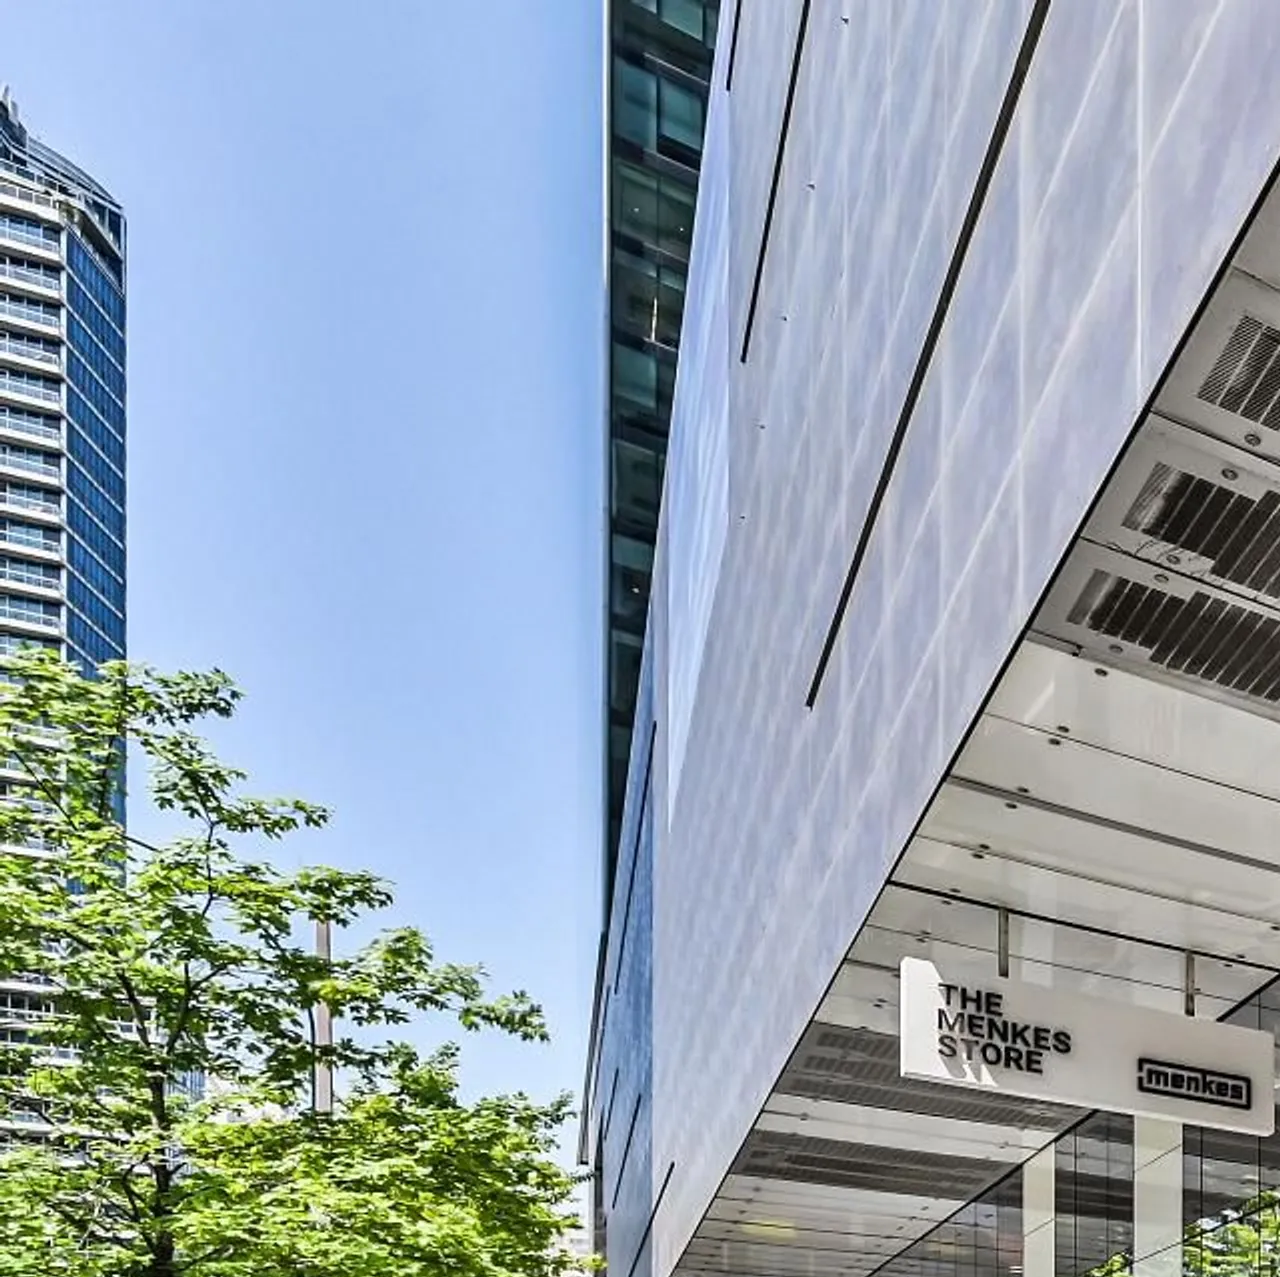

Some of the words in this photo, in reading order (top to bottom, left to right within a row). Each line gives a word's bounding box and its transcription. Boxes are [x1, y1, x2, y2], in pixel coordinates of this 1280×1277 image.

[938, 983, 1003, 1017] THE
[938, 1008, 1071, 1054] MENKES
[938, 1035, 1043, 1075] STORE
[1146, 1066, 1244, 1100] menkes
